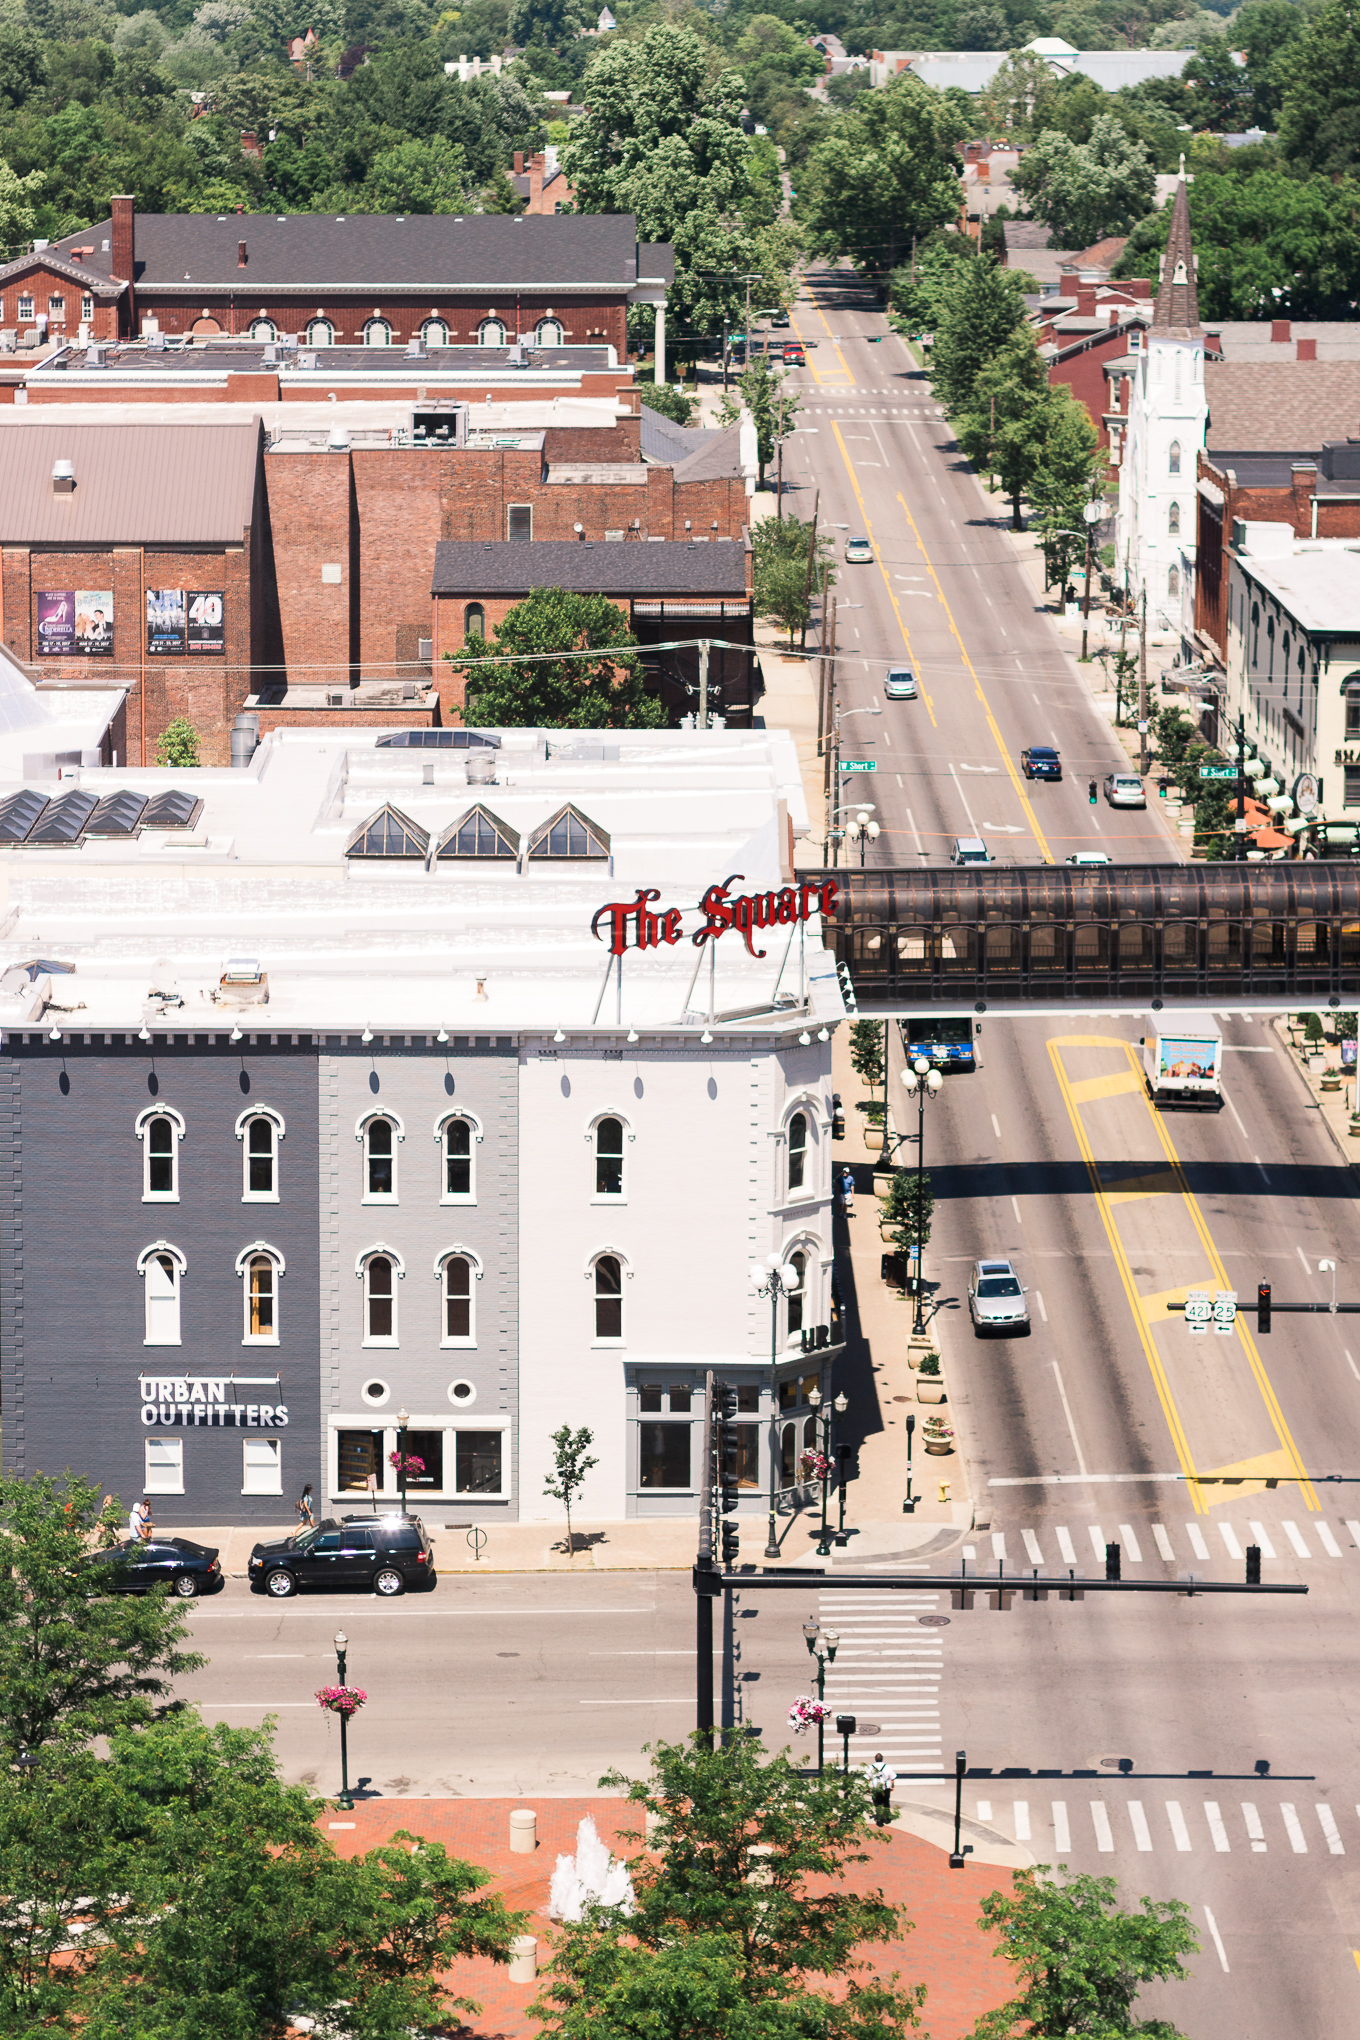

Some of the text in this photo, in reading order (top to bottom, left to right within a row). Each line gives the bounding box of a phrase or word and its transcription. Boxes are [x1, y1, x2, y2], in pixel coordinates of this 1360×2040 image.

[189, 596, 222, 624] 40
[591, 874, 839, 958] The Square
[1189, 1306, 1208, 1317] 421
[1217, 1306, 1233, 1317] 25
[141, 1382, 225, 1402] URBAN
[141, 1404, 289, 1427] OUTFITTERS
